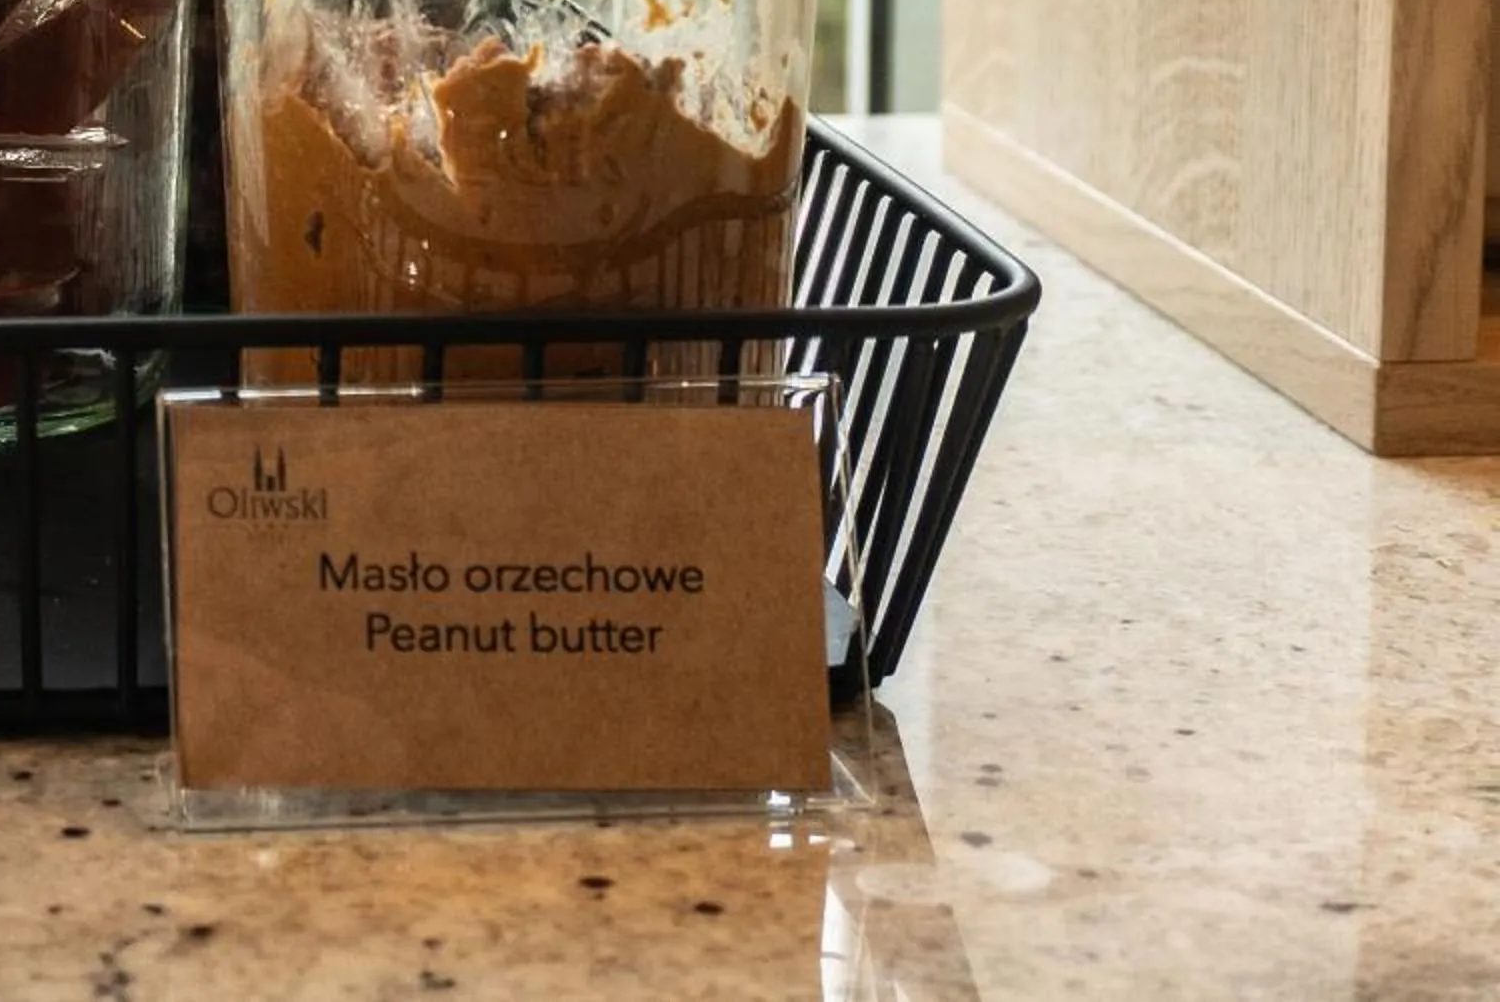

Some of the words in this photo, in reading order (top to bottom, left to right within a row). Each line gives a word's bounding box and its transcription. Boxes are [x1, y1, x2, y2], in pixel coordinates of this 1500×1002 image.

[207, 485, 327, 519] Oliwski
[319, 551, 450, 593] Masło
[464, 552, 704, 594] orzechowe
[366, 613, 516, 653] Peanut
[530, 611, 664, 654] butter
